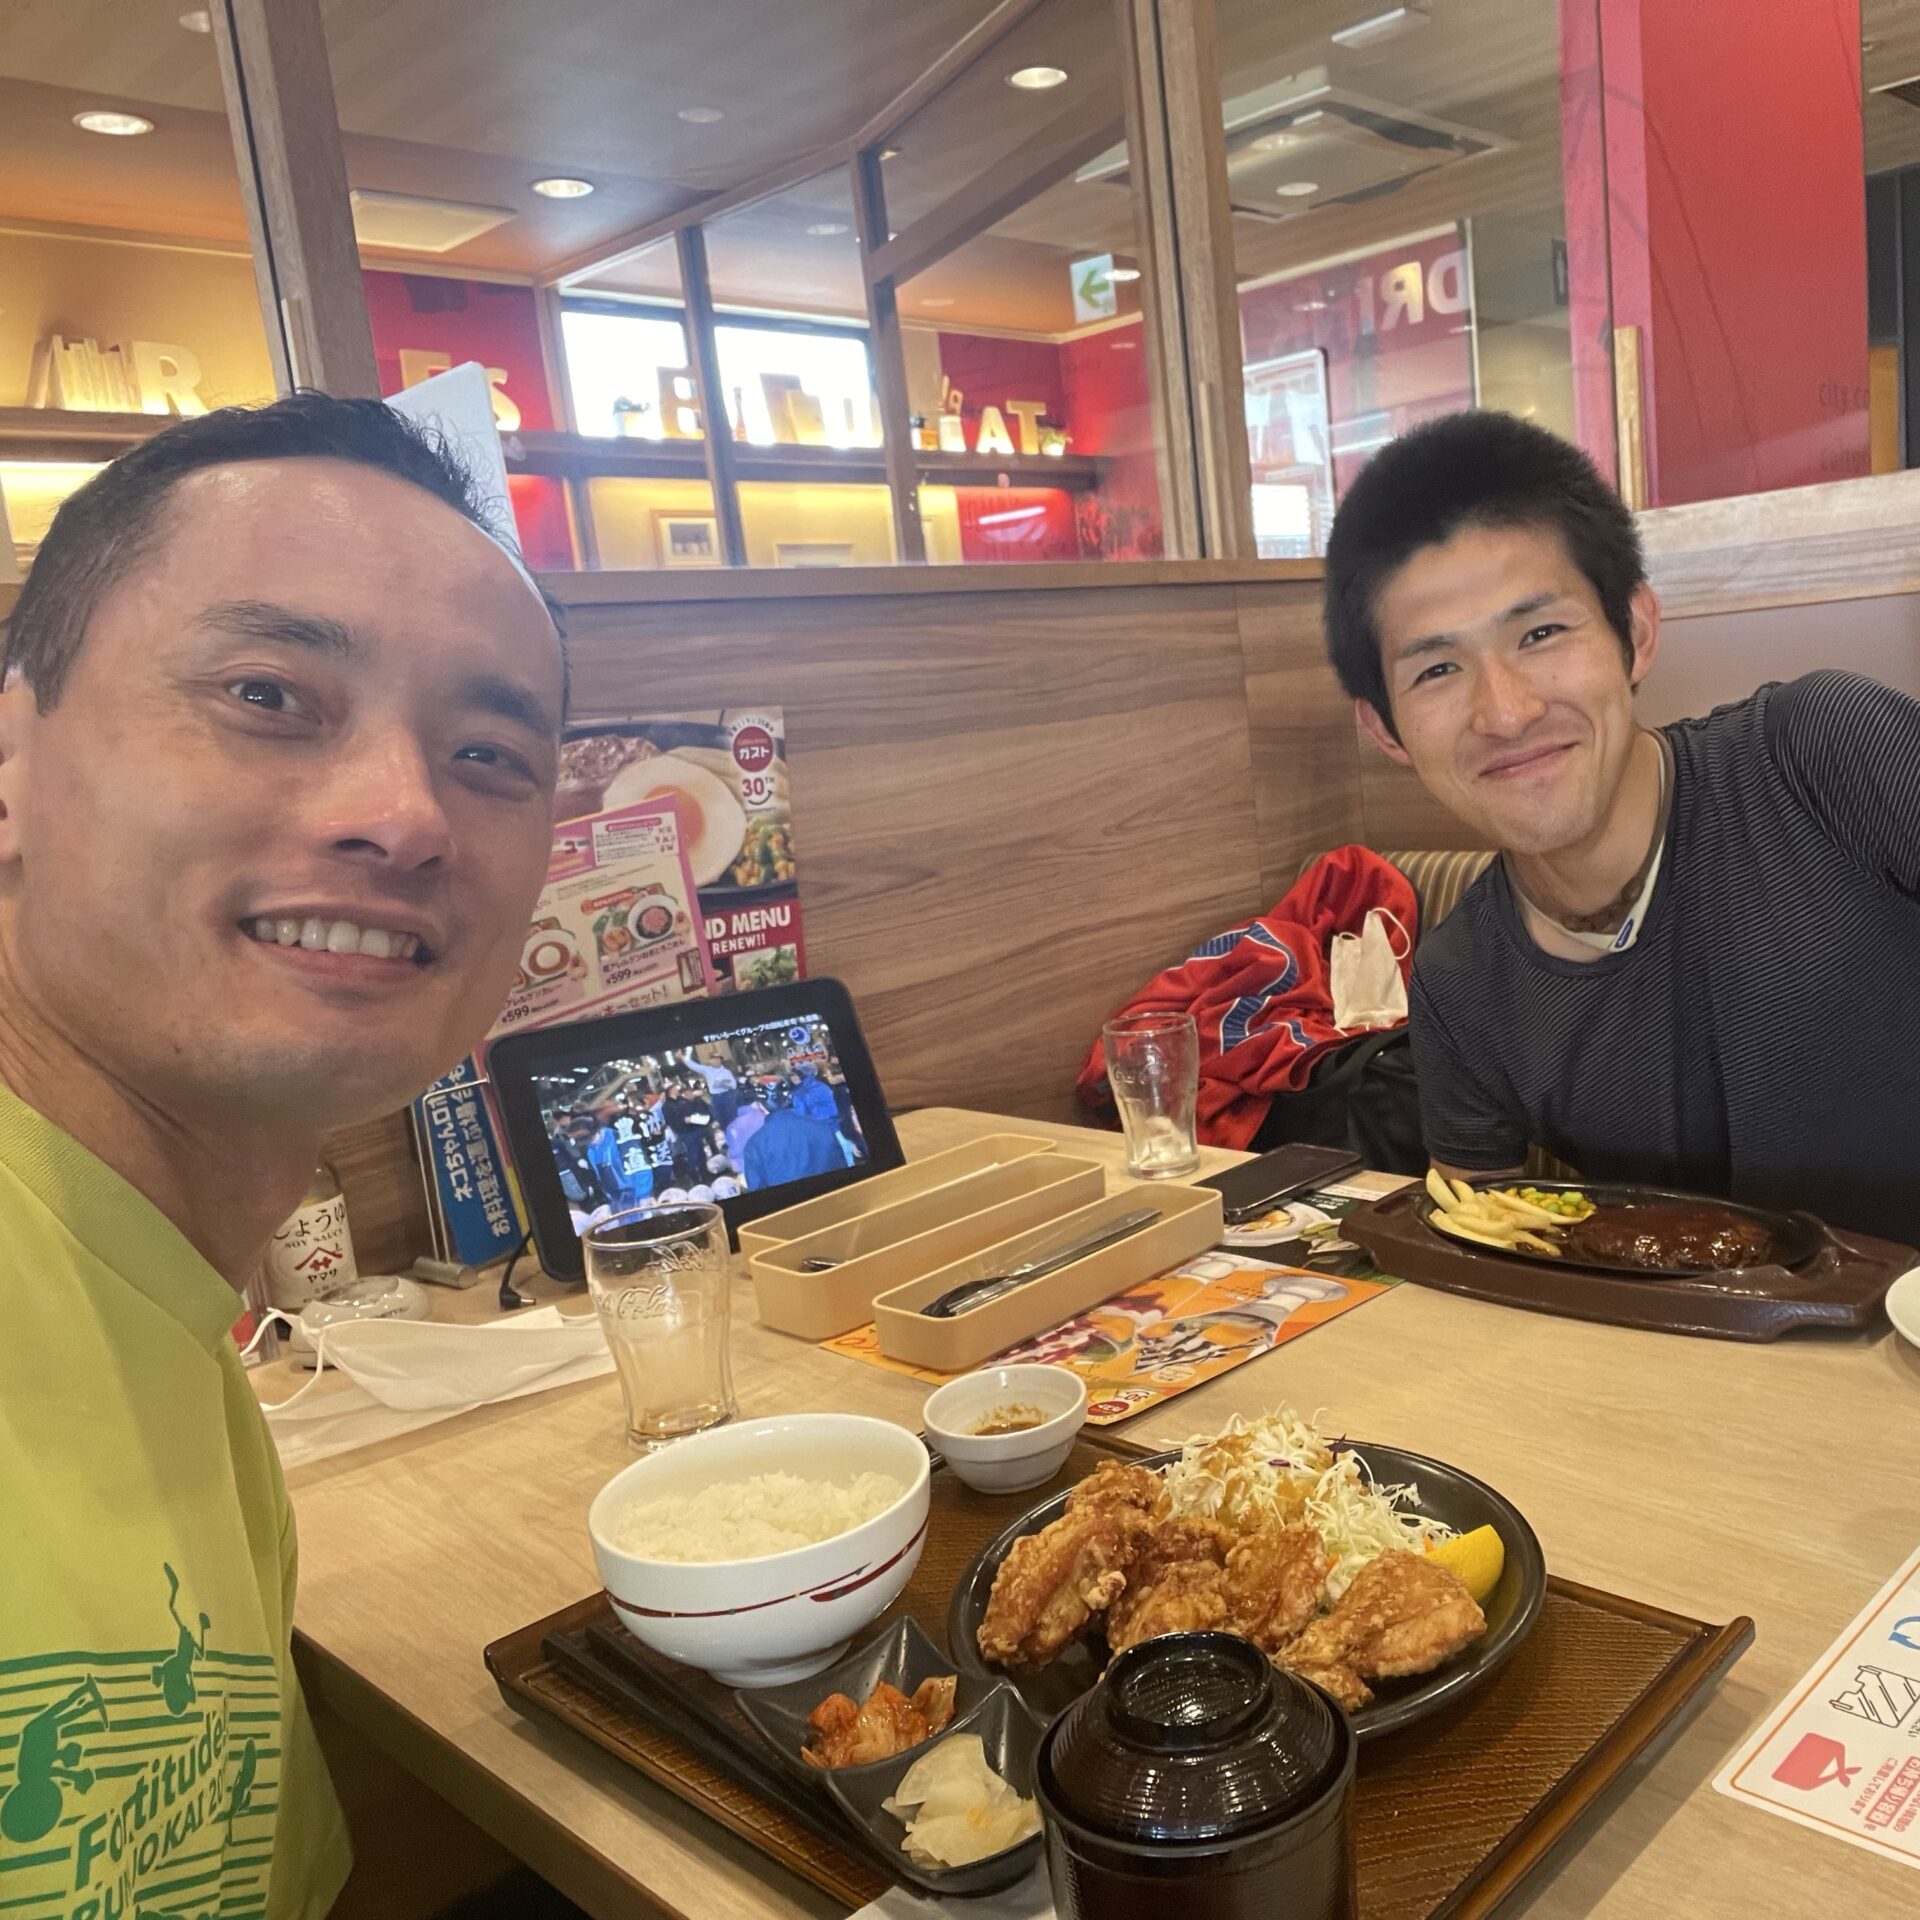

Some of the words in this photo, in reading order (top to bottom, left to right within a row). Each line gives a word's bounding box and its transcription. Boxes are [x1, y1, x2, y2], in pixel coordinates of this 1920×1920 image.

[132, 340, 210, 416] R
[738, 746, 770, 760] ガスト
[742, 777, 765, 797] 30
[731, 904, 791, 935] MENU
[712, 933, 767, 955] RENEW!!
